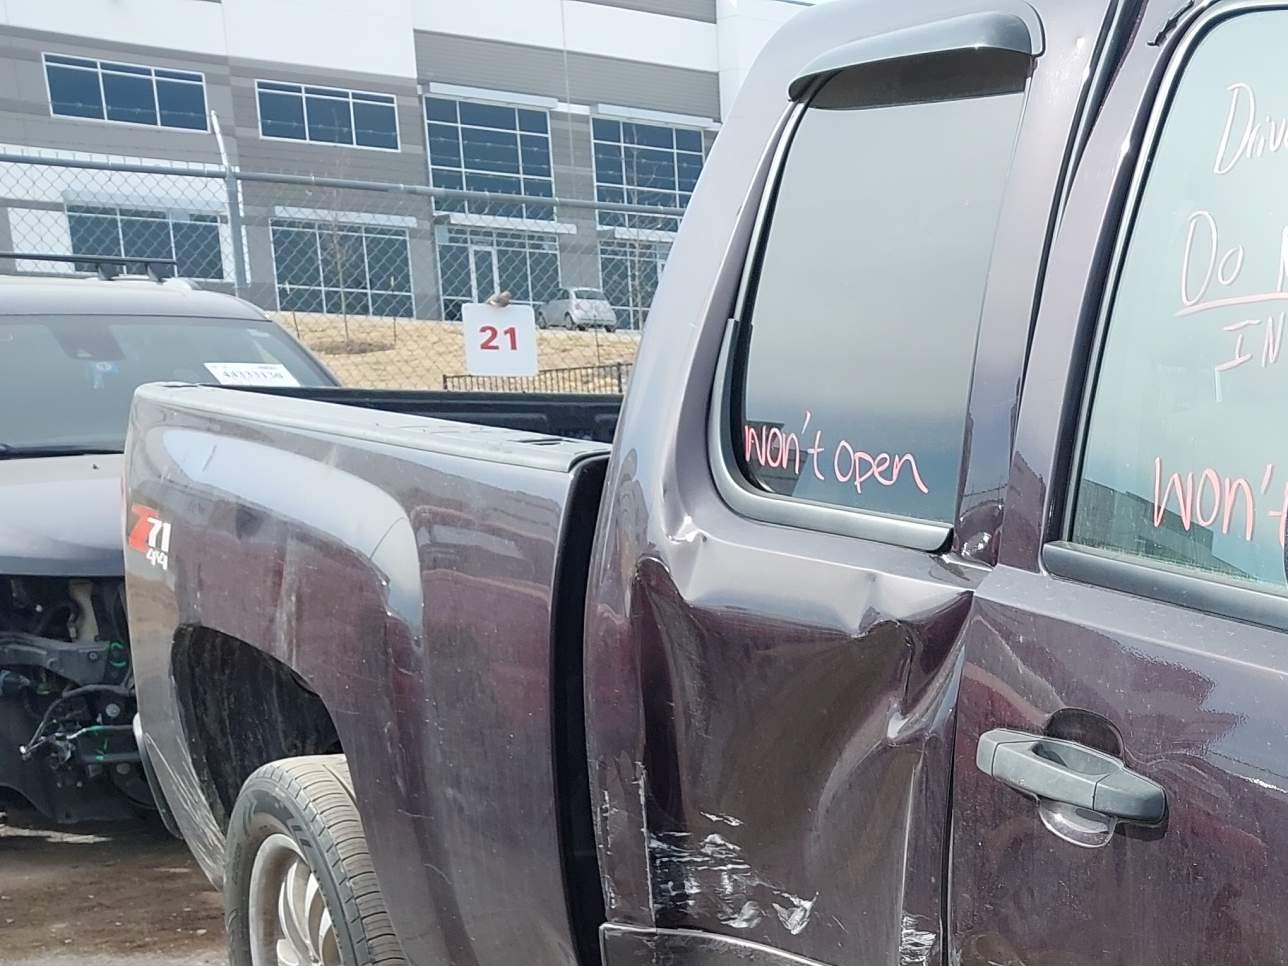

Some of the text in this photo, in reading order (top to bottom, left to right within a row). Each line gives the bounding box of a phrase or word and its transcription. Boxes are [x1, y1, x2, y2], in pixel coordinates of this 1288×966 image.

[479, 326, 517, 351] 21
[1215, 311, 1286, 372] IN
[128, 503, 171, 553] Z71
